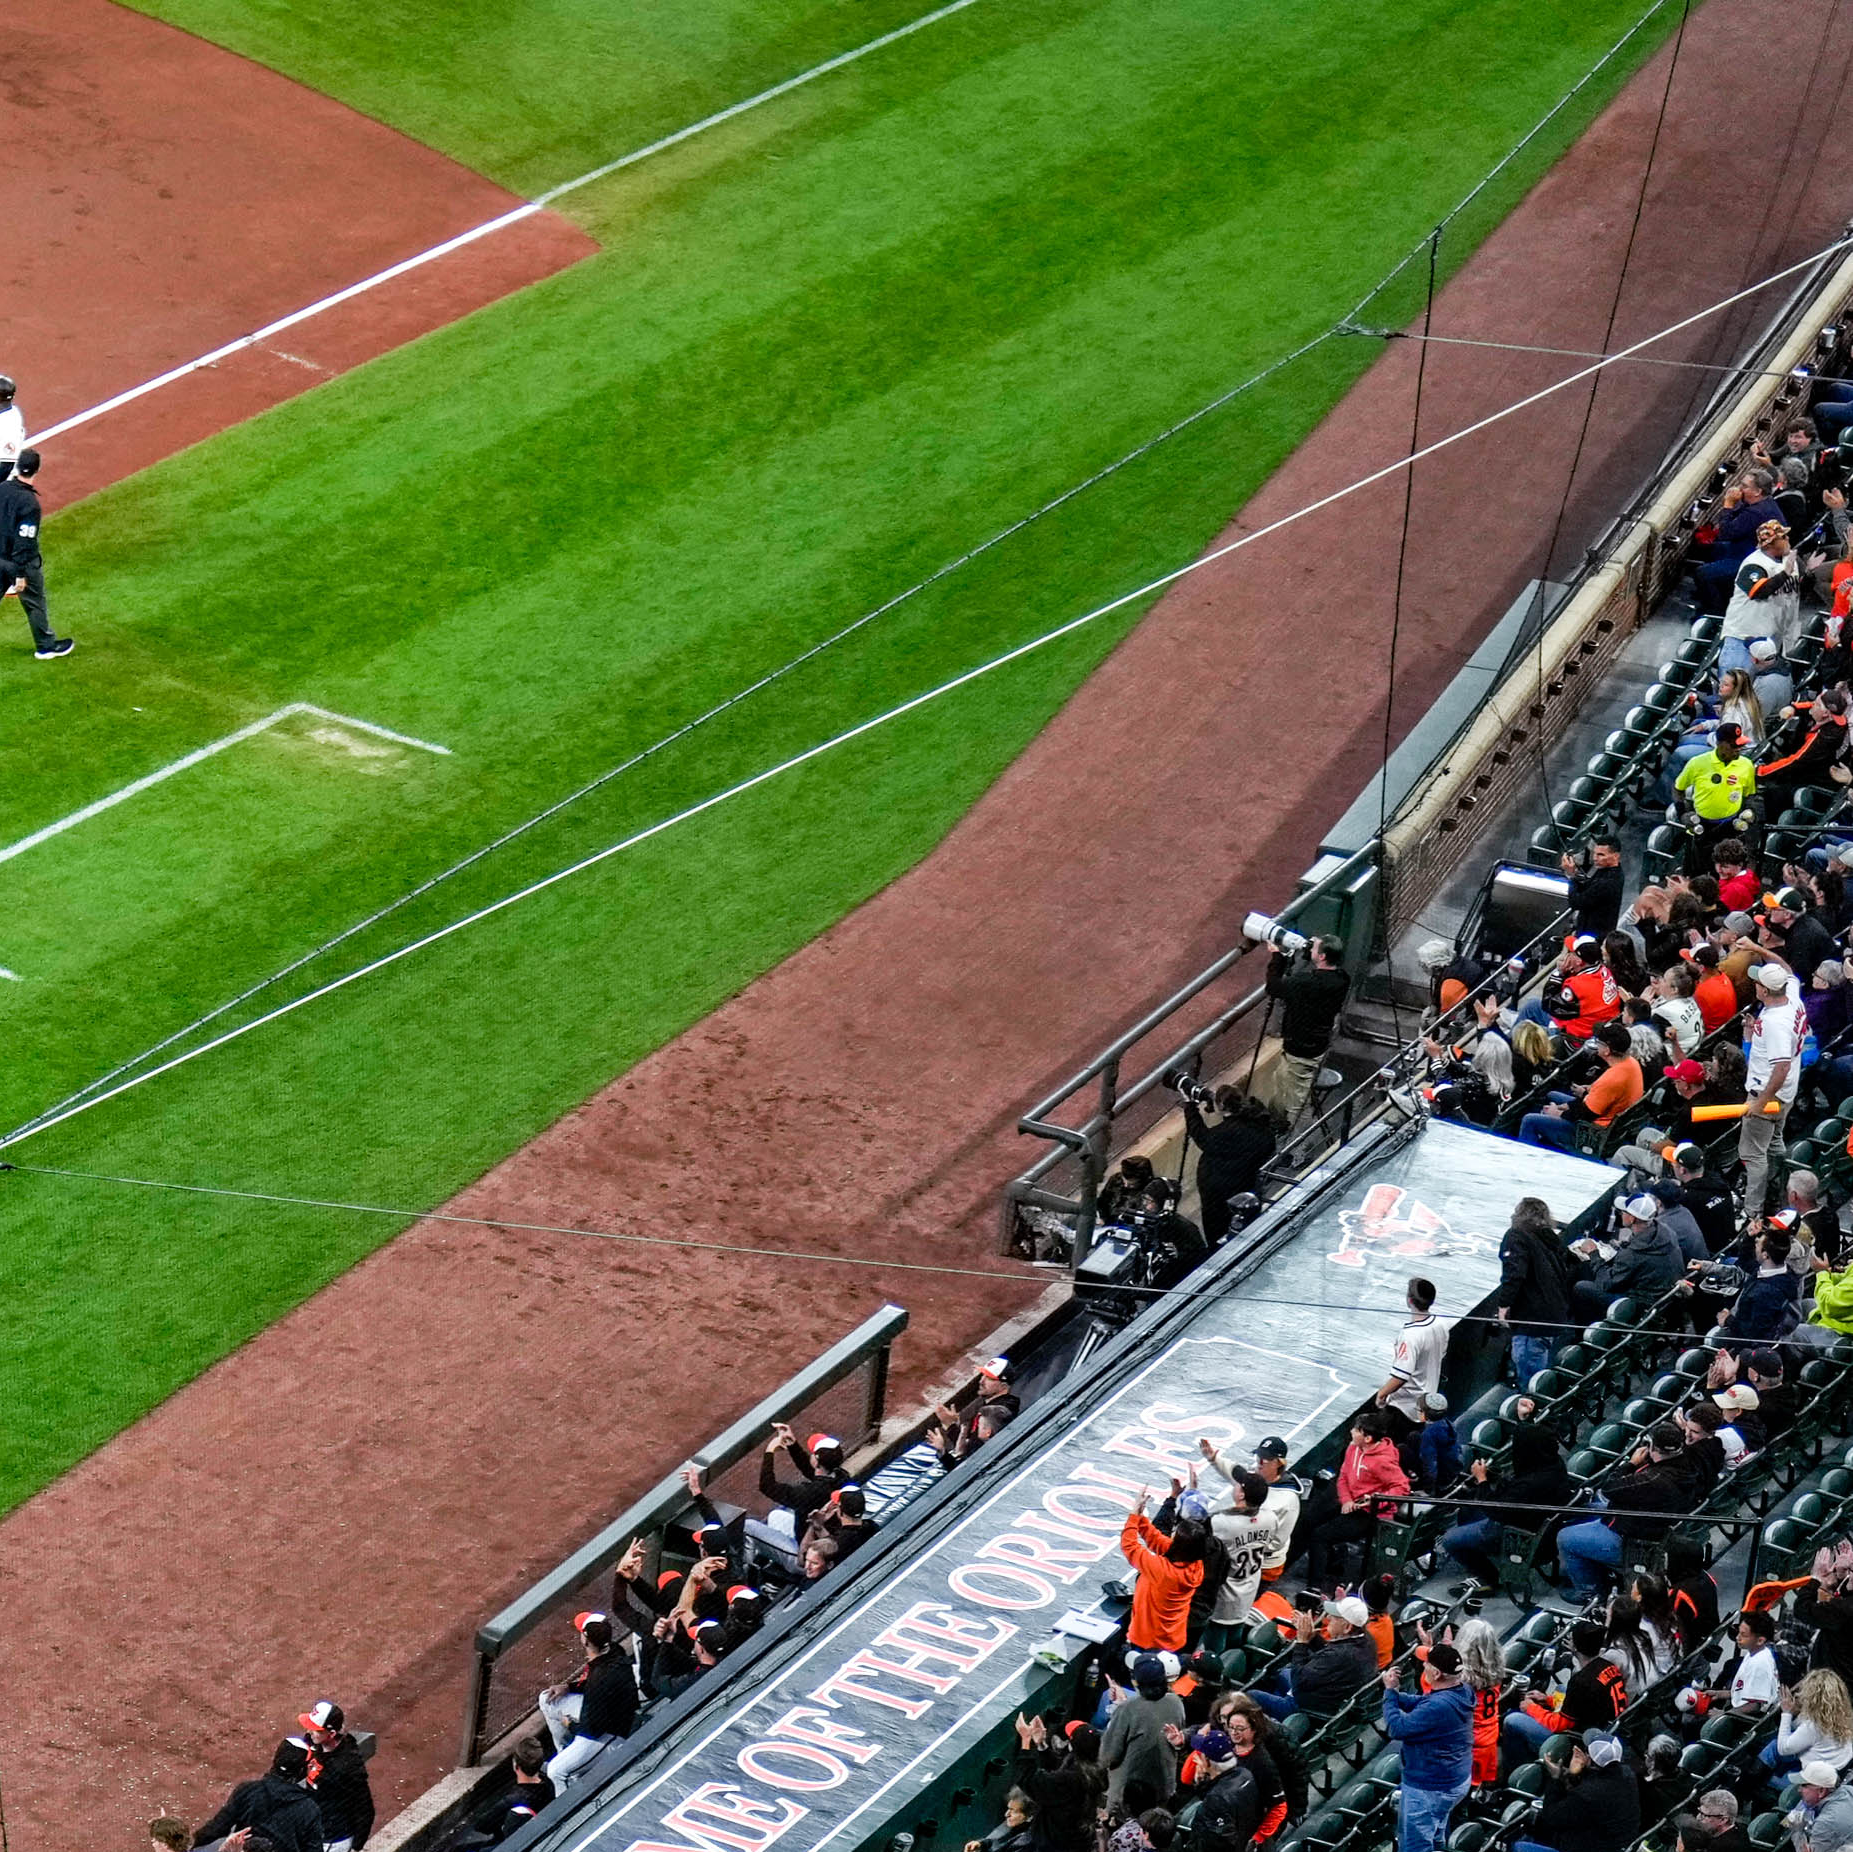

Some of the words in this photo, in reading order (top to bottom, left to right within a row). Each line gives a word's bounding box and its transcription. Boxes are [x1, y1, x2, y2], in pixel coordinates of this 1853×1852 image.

[18, 523, 37, 538] 39
[947, 1400, 1247, 1611] ORIOLES
[1233, 1547, 1265, 1580] 25
[1235, 1529, 1270, 1549] ALONSO
[807, 1602, 1021, 1721] THE
[736, 1706, 885, 1793] OF
